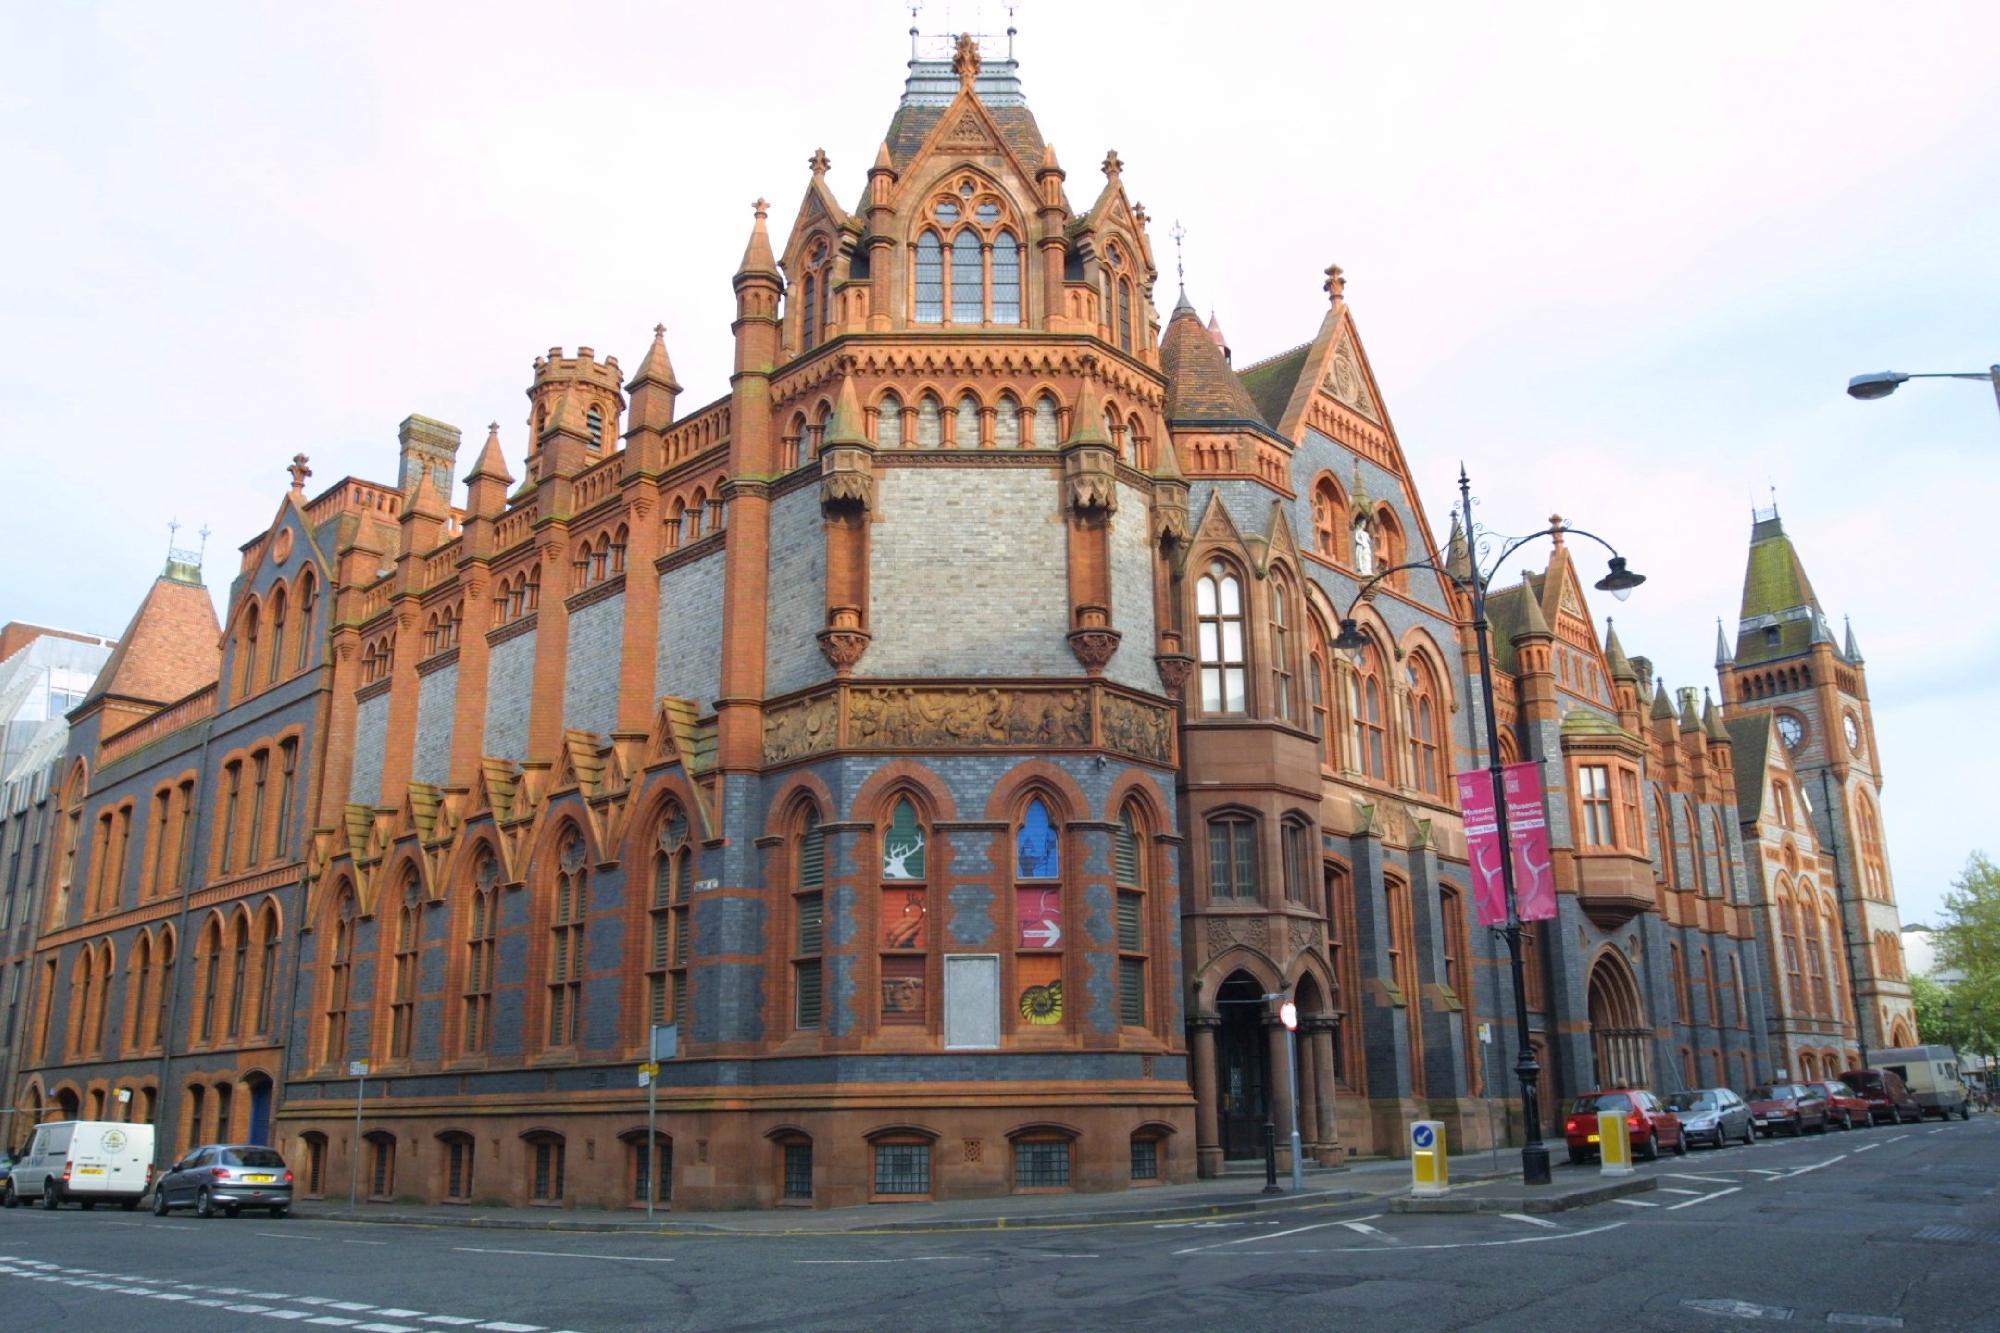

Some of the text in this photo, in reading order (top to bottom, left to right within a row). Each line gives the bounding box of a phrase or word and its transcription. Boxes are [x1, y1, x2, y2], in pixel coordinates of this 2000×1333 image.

[1508, 801, 1542, 810] Museum
[1463, 807, 1495, 817] Museum
[1516, 809, 1543, 817] Reading
